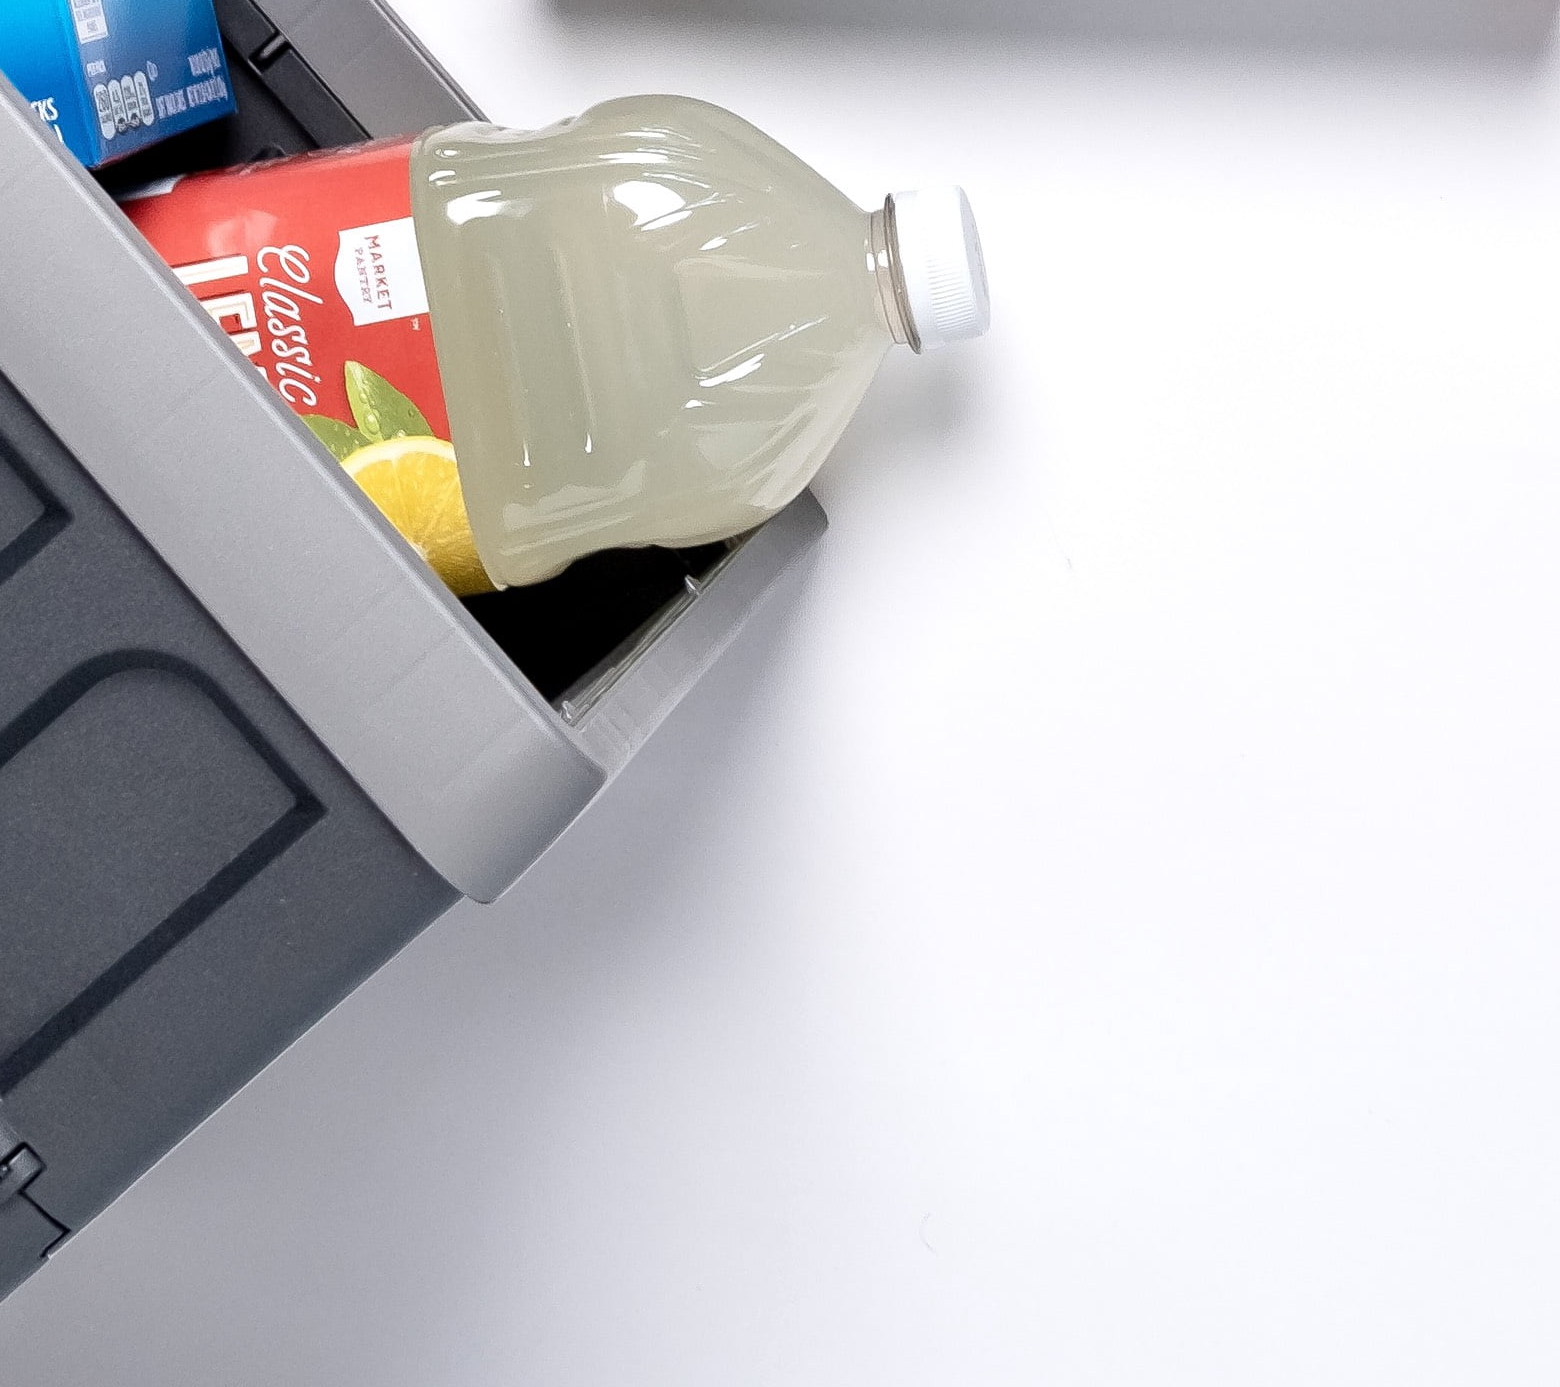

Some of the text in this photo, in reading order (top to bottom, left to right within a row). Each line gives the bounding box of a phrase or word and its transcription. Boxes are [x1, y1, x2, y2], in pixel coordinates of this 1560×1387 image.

[352, 246, 374, 306] PANTRY
[364, 234, 394, 312] MARKET
[256, 243, 324, 407] Classic
